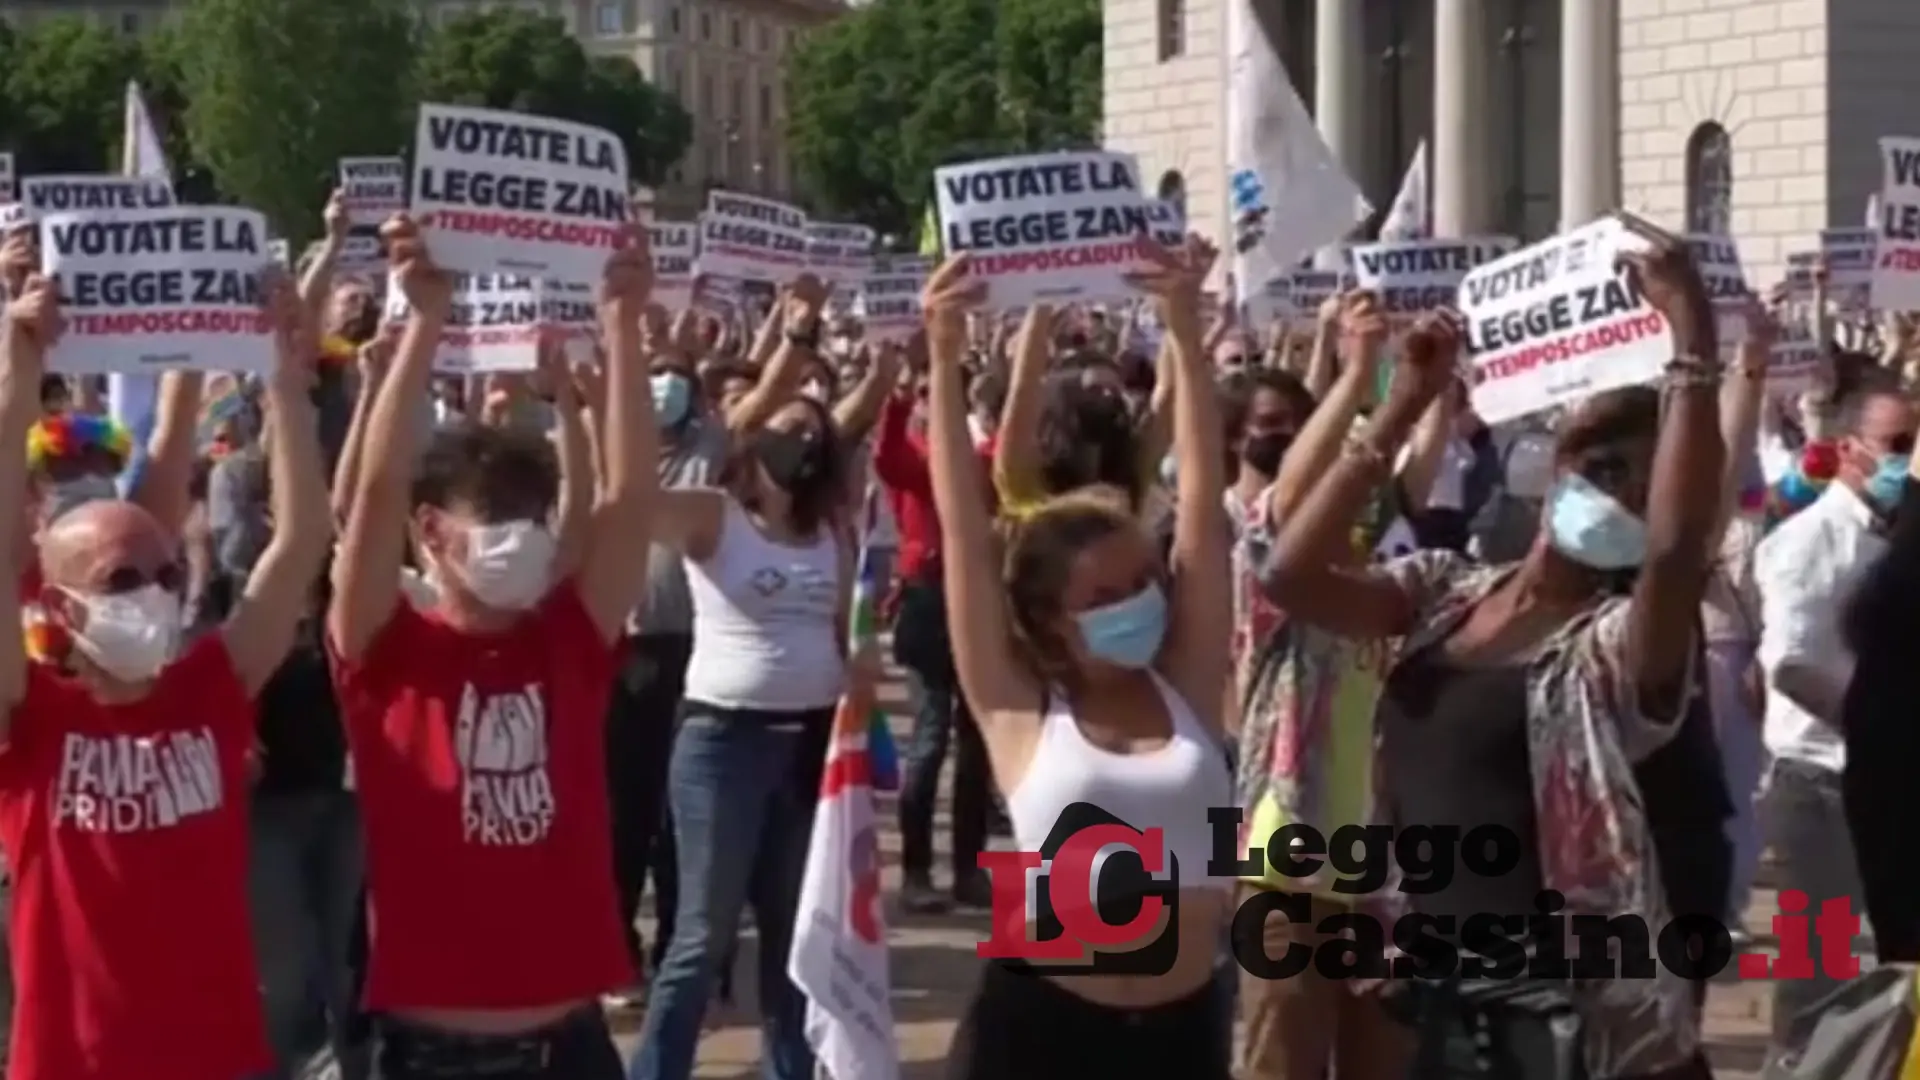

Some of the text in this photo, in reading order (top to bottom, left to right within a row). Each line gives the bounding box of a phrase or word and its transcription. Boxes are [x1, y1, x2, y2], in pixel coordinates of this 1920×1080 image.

[430, 117, 617, 174] VOTATE LA
[29, 183, 138, 209] VOTATE
[421, 168, 626, 222] LEGGE ZAN
[947, 161, 1133, 204] VOTATE LA
[53, 216, 258, 255] VOTATE LA
[949, 205, 1148, 252] LEGGE ZAN
[1361, 246, 1469, 275] VOTATE
[482, 300, 536, 325] ZAN
[1383, 287, 1459, 312] EGGE
[1466, 293, 1573, 354] LEGGE
